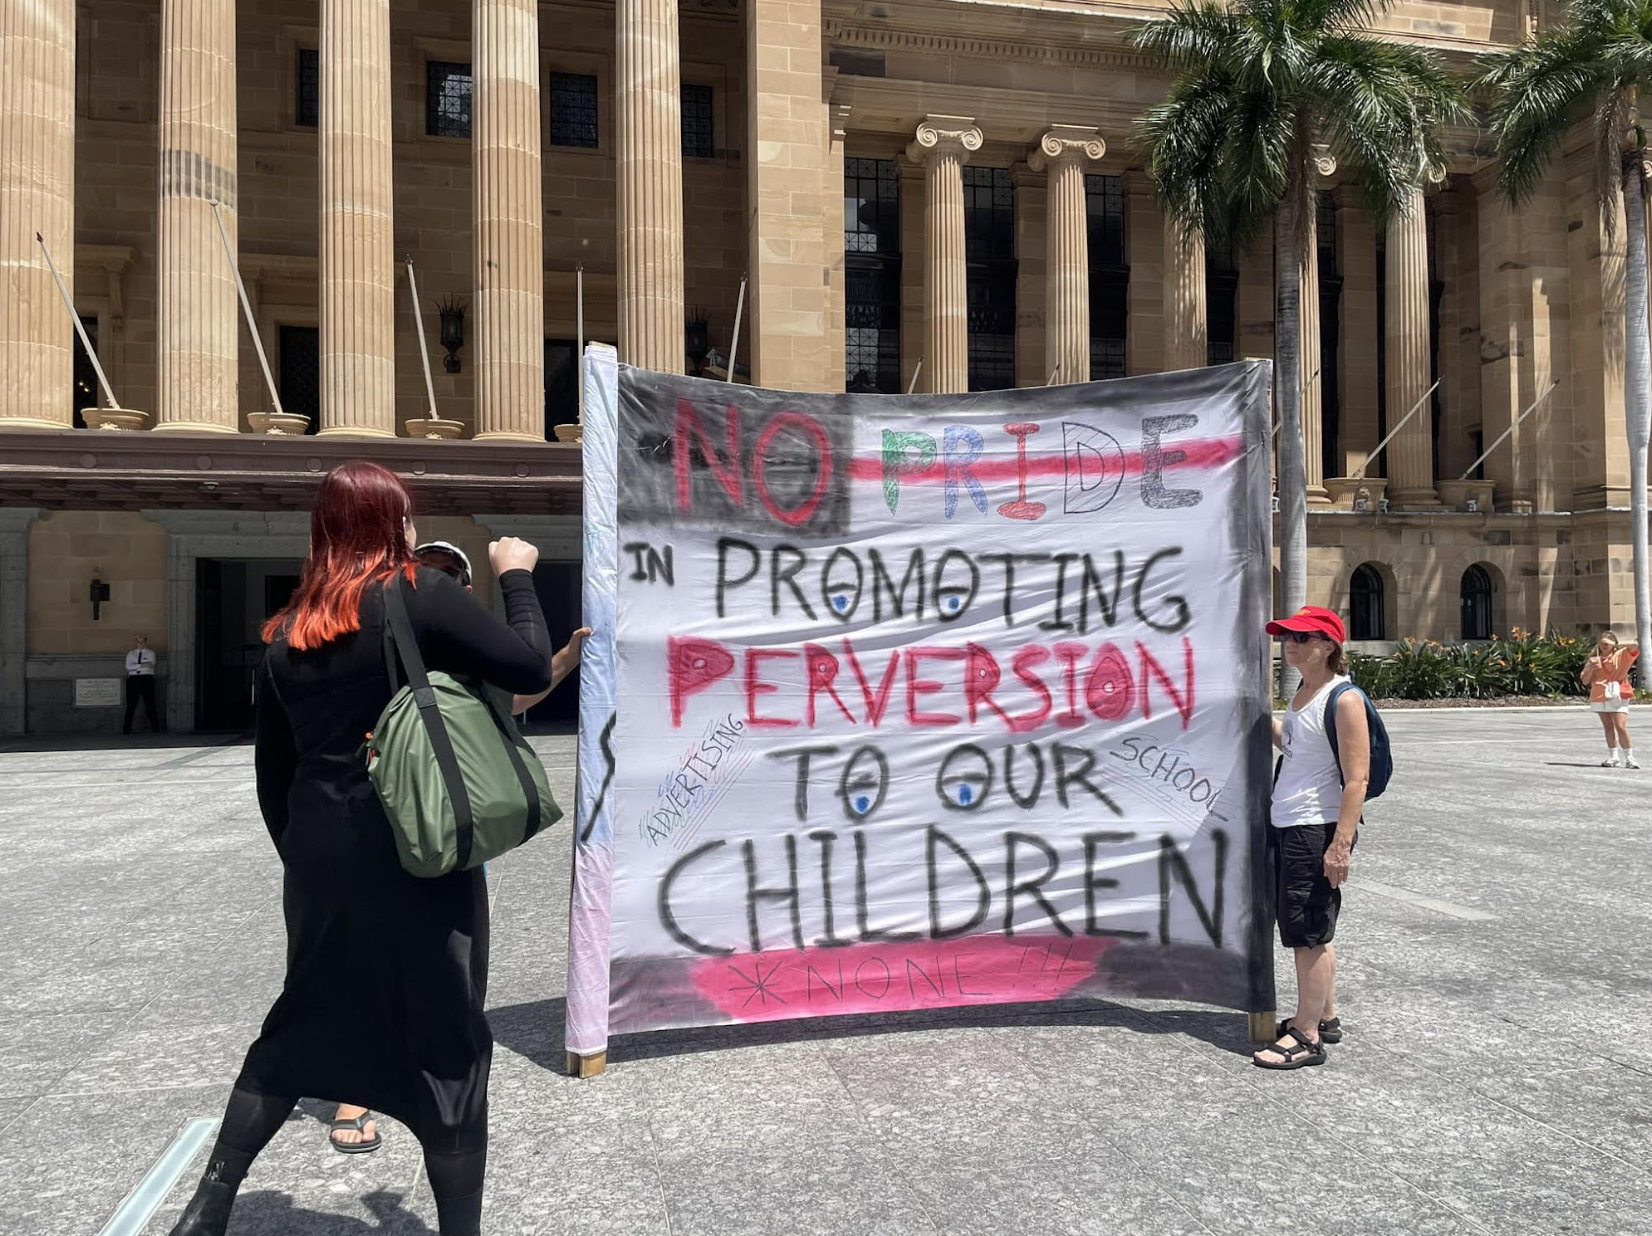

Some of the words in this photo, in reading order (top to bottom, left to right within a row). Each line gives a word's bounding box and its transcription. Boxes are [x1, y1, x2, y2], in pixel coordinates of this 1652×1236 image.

[671, 398, 834, 527] NO
[881, 414, 1203, 520] PRIDE
[624, 541, 674, 587] IN
[716, 537, 1192, 632] PROMOTING
[667, 634, 1196, 731] PERVERSION
[646, 712, 744, 847] ADVERTISING
[766, 744, 889, 822] TO
[936, 742, 1124, 816] OUR
[1109, 736, 1229, 822] SCHOOL
[658, 822, 1232, 957] CHILDREN
